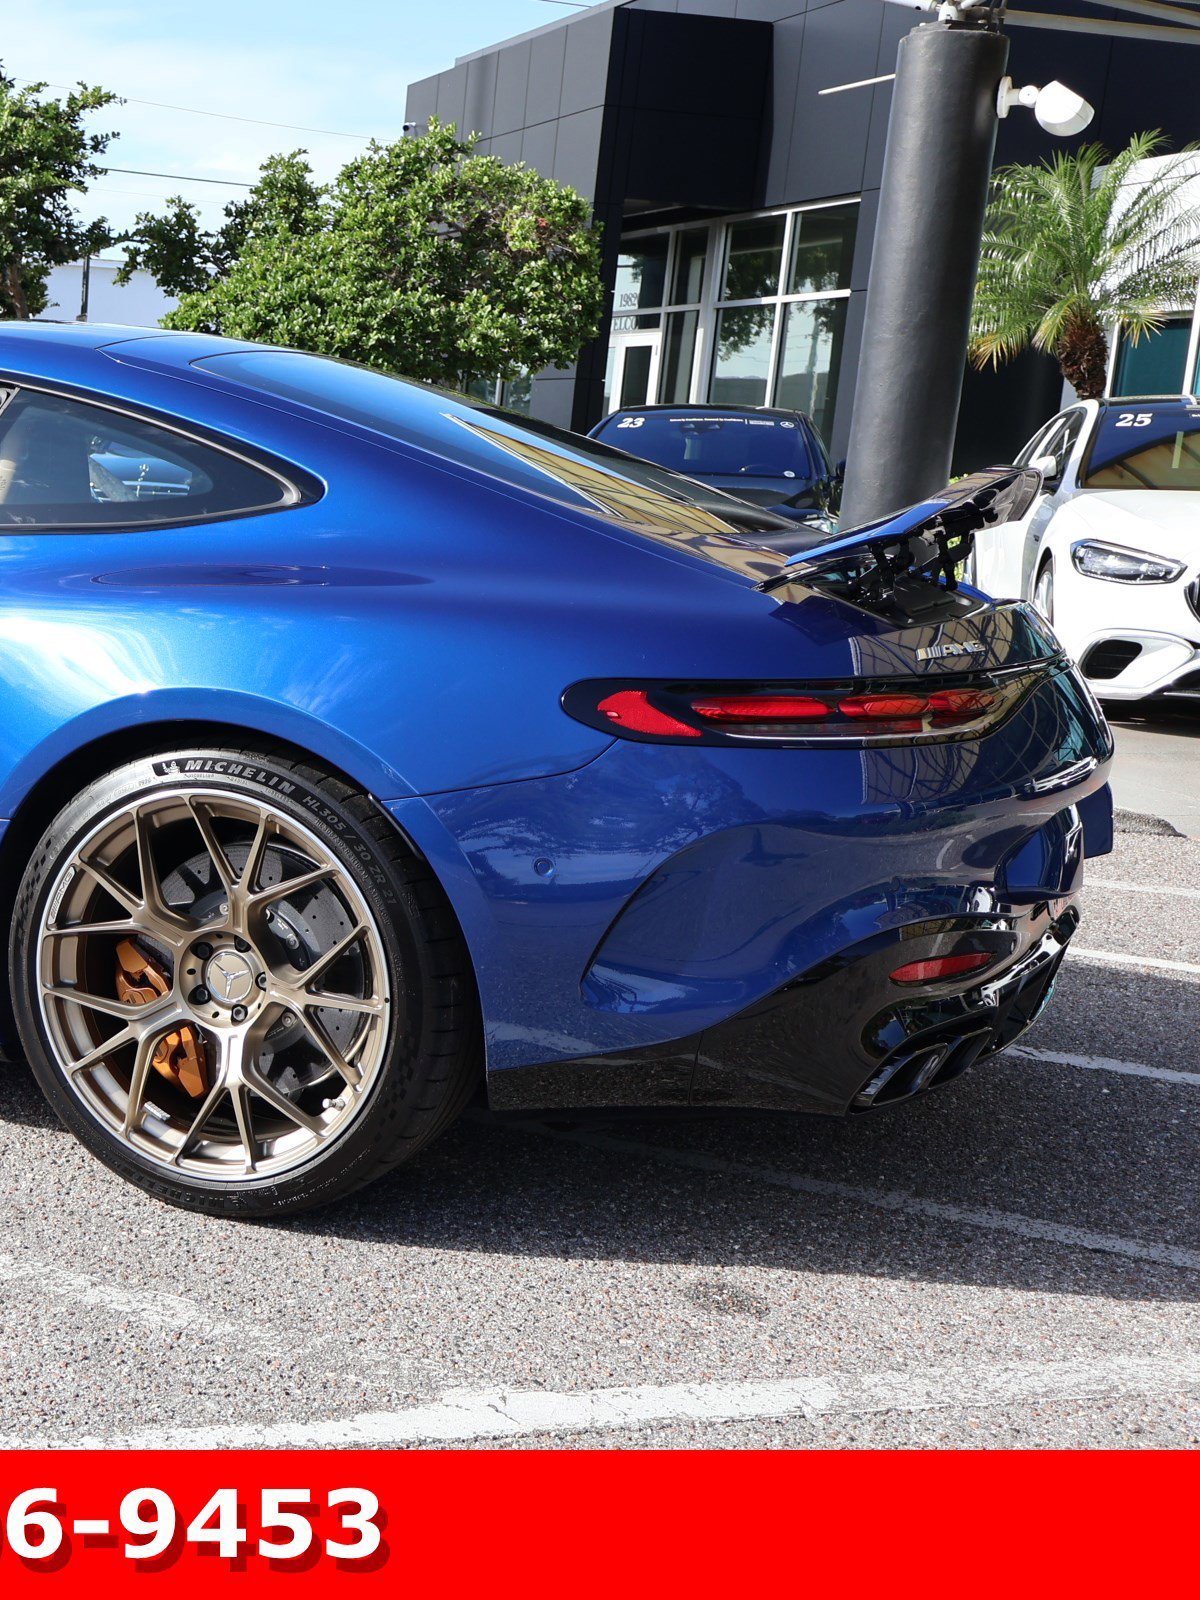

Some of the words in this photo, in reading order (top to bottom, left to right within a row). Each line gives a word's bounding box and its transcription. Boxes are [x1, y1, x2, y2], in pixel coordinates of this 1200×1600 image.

[617, 417, 645, 428] 23
[1115, 412, 1153, 427] 25
[184, 760, 296, 794] MICHELIN
[302, 795, 347, 832] HL305
[354, 843, 371, 860] 30
[368, 864, 386, 884] ZR
[54, 871, 73, 908] AMG
